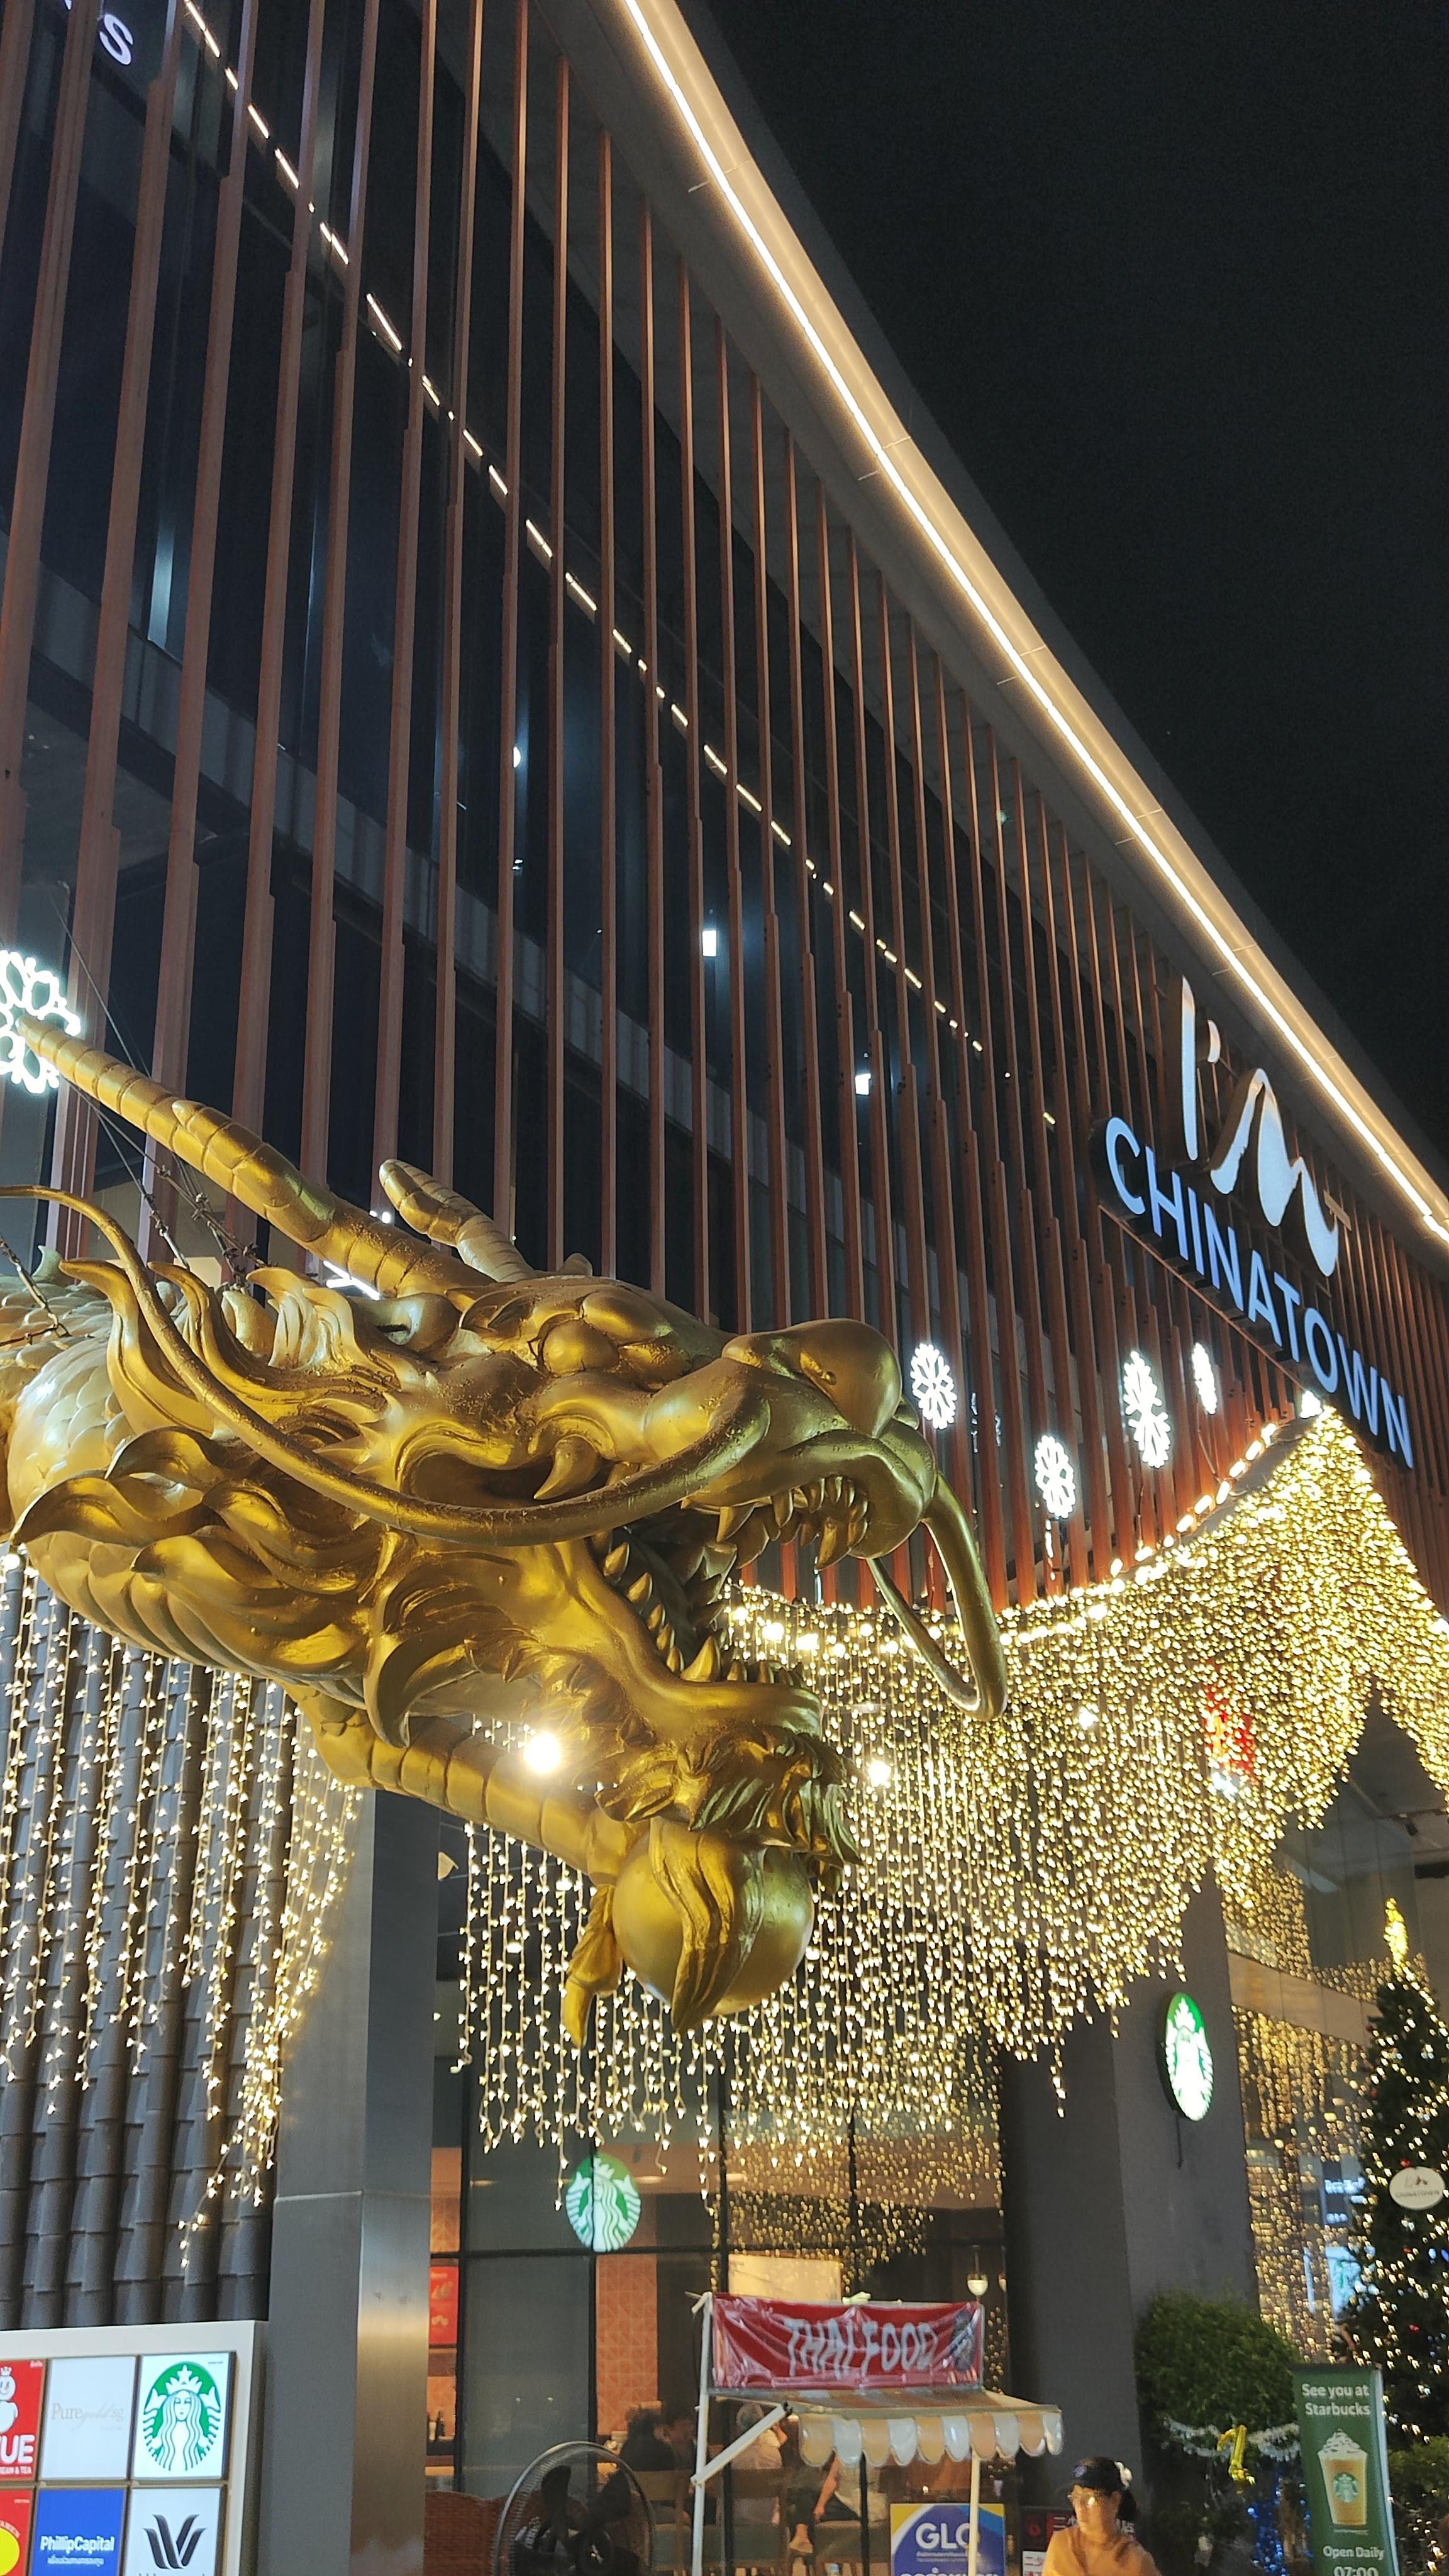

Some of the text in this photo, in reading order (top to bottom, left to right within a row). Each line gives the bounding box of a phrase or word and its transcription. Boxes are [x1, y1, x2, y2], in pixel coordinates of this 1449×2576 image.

[1105, 1117, 1414, 1469] CHINATOWN
[784, 2318, 938, 2380] THAI FOOD
[1301, 2383, 1370, 2399] See you at
[1304, 2402, 1371, 2416] Starbucks
[1323, 2545, 1384, 2560] Open Daily
